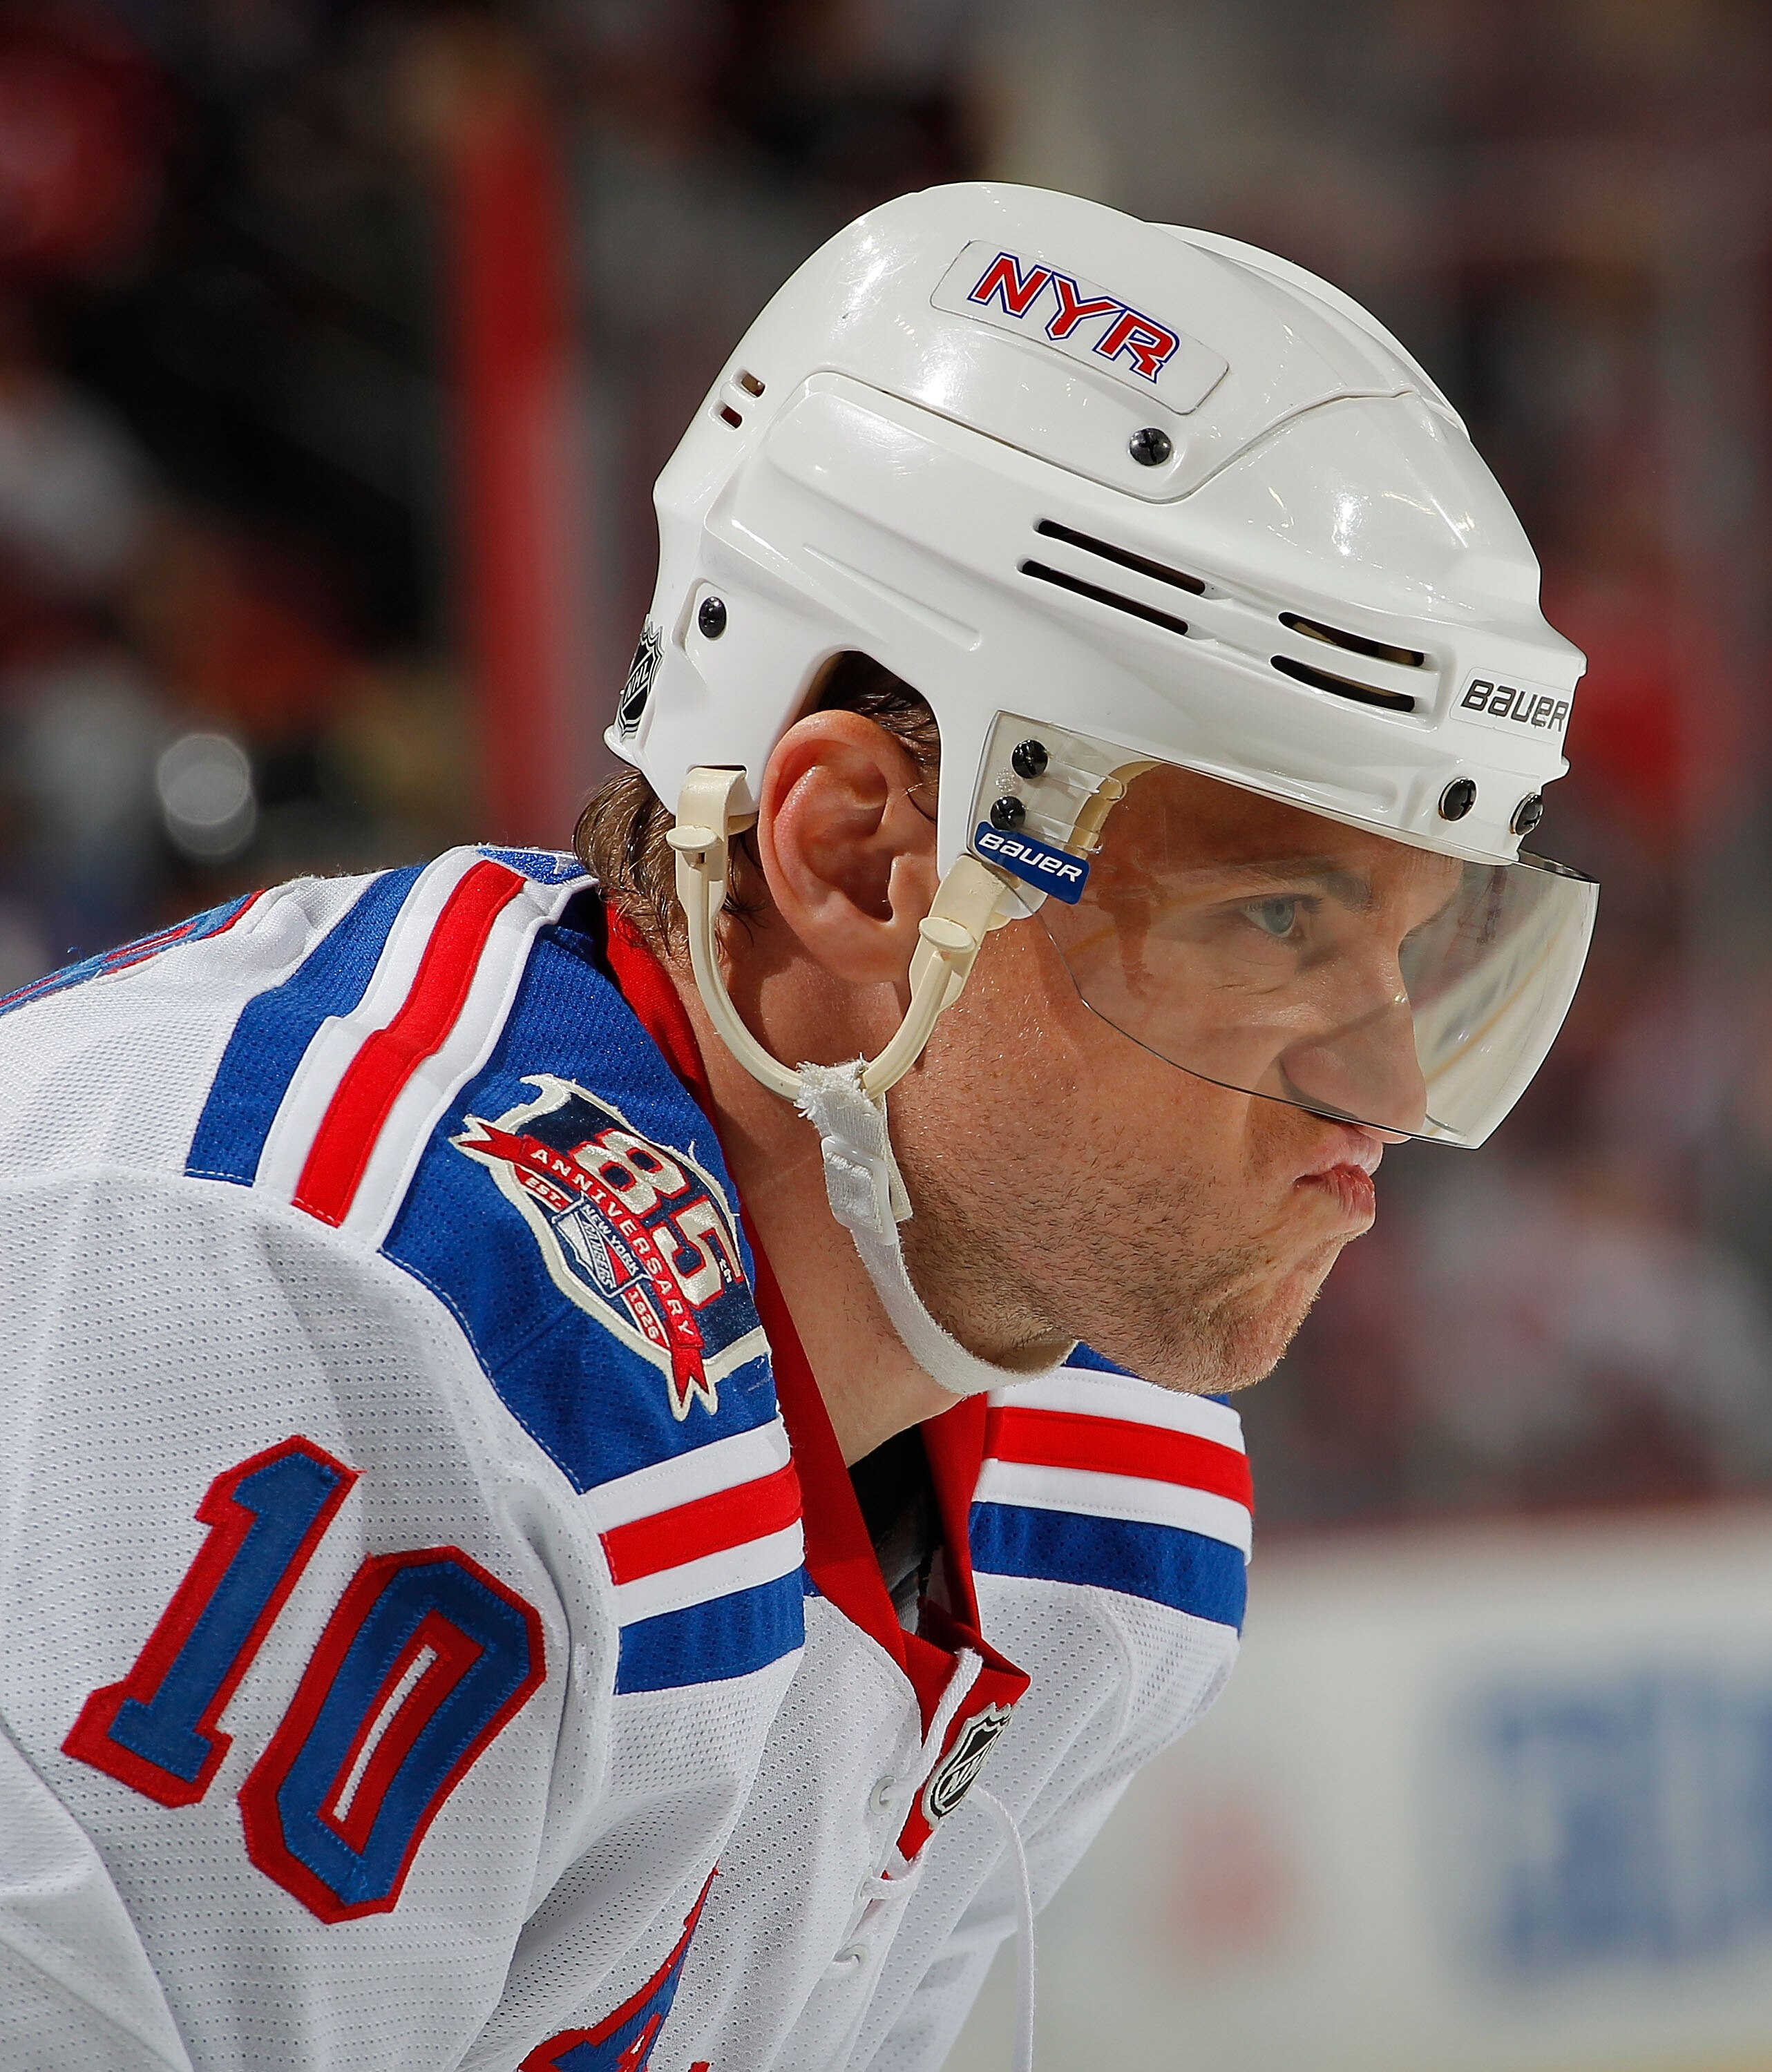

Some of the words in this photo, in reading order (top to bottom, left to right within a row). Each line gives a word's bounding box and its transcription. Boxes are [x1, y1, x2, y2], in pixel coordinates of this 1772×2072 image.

[967, 251, 1180, 384] NYR
[623, 661, 649, 704] NHL
[1460, 679, 1570, 732] BAUER
[978, 833, 1083, 883] BAUER
[529, 1149, 694, 1336] ANNIVERSARY
[581, 1205, 612, 1234] NEW
[611, 1236, 640, 1276] YORK
[628, 1291, 660, 1339] 1926
[60, 1434, 547, 1925] 10
